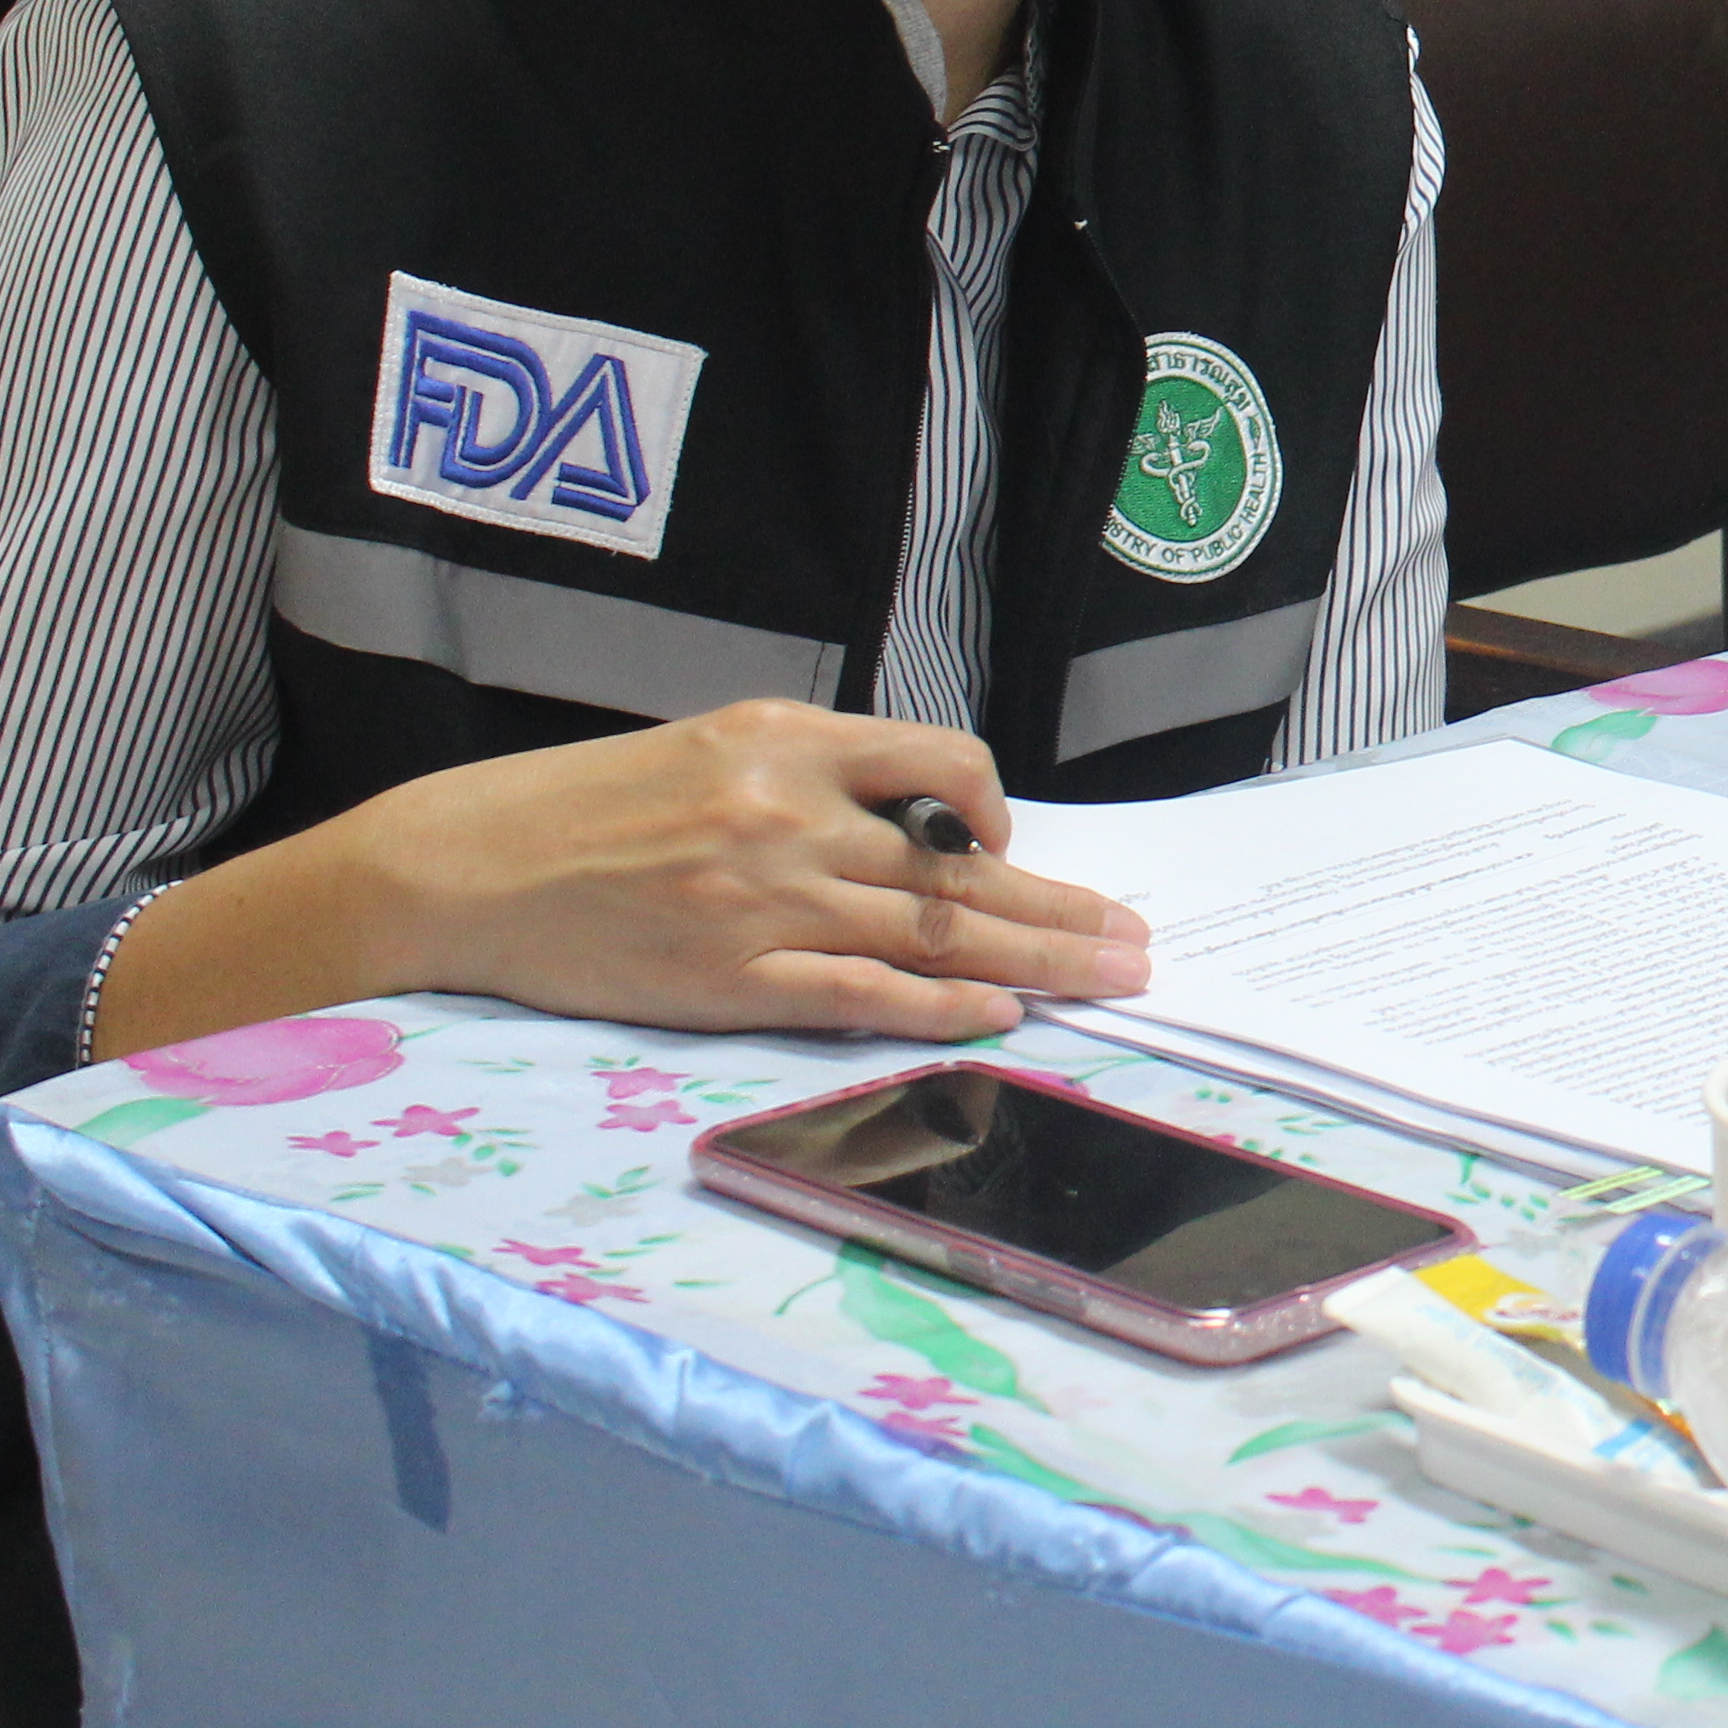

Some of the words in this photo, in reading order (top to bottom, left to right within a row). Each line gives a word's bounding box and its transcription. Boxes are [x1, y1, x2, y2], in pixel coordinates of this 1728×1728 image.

[389, 309, 651, 523] FDA
[1161, 547, 1188, 565] OF
[1191, 525, 1243, 563] PUBLIC
[1239, 453, 1268, 525] HEALTH
